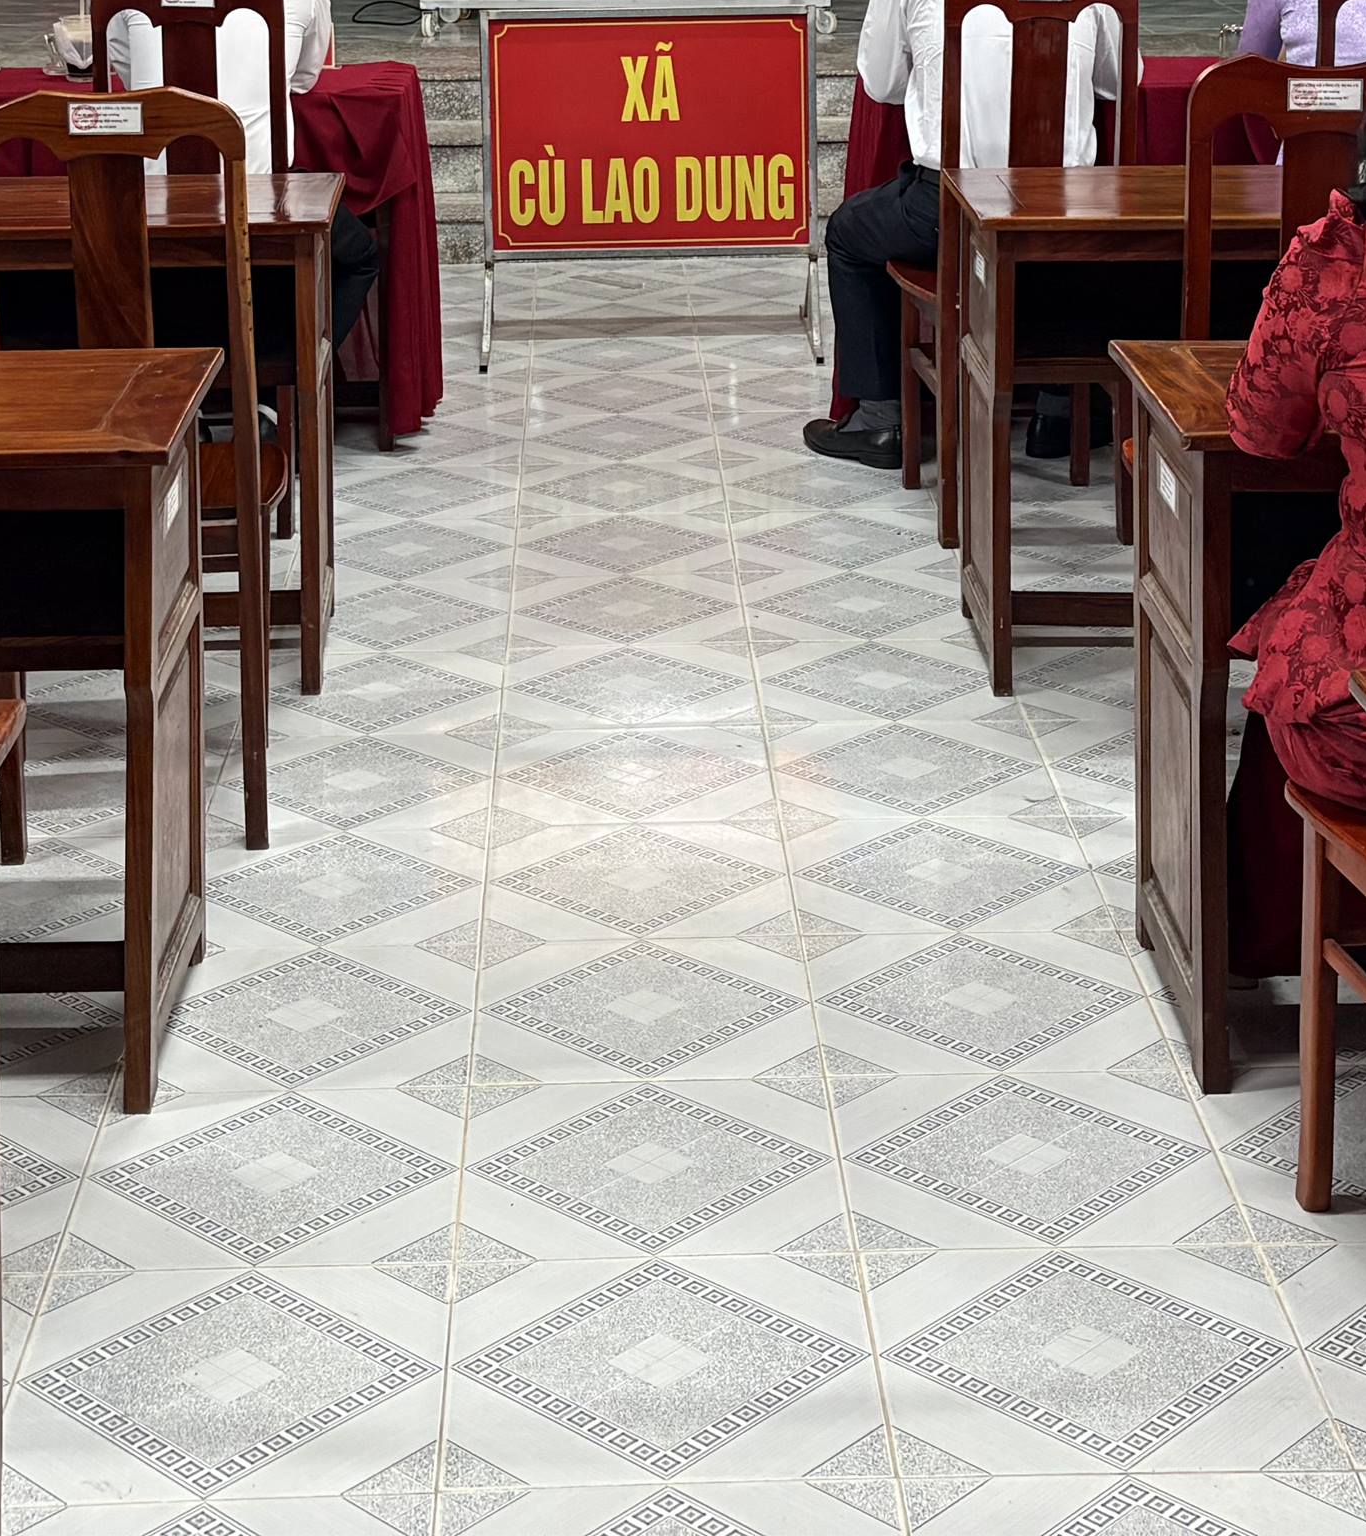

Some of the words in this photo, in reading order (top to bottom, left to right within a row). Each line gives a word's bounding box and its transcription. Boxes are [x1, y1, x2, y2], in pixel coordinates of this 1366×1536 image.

[620, 41, 681, 122] XÃ
[508, 144, 566, 226] CÙ
[581, 156, 660, 224] LAO
[675, 153, 796, 222] DUNG
